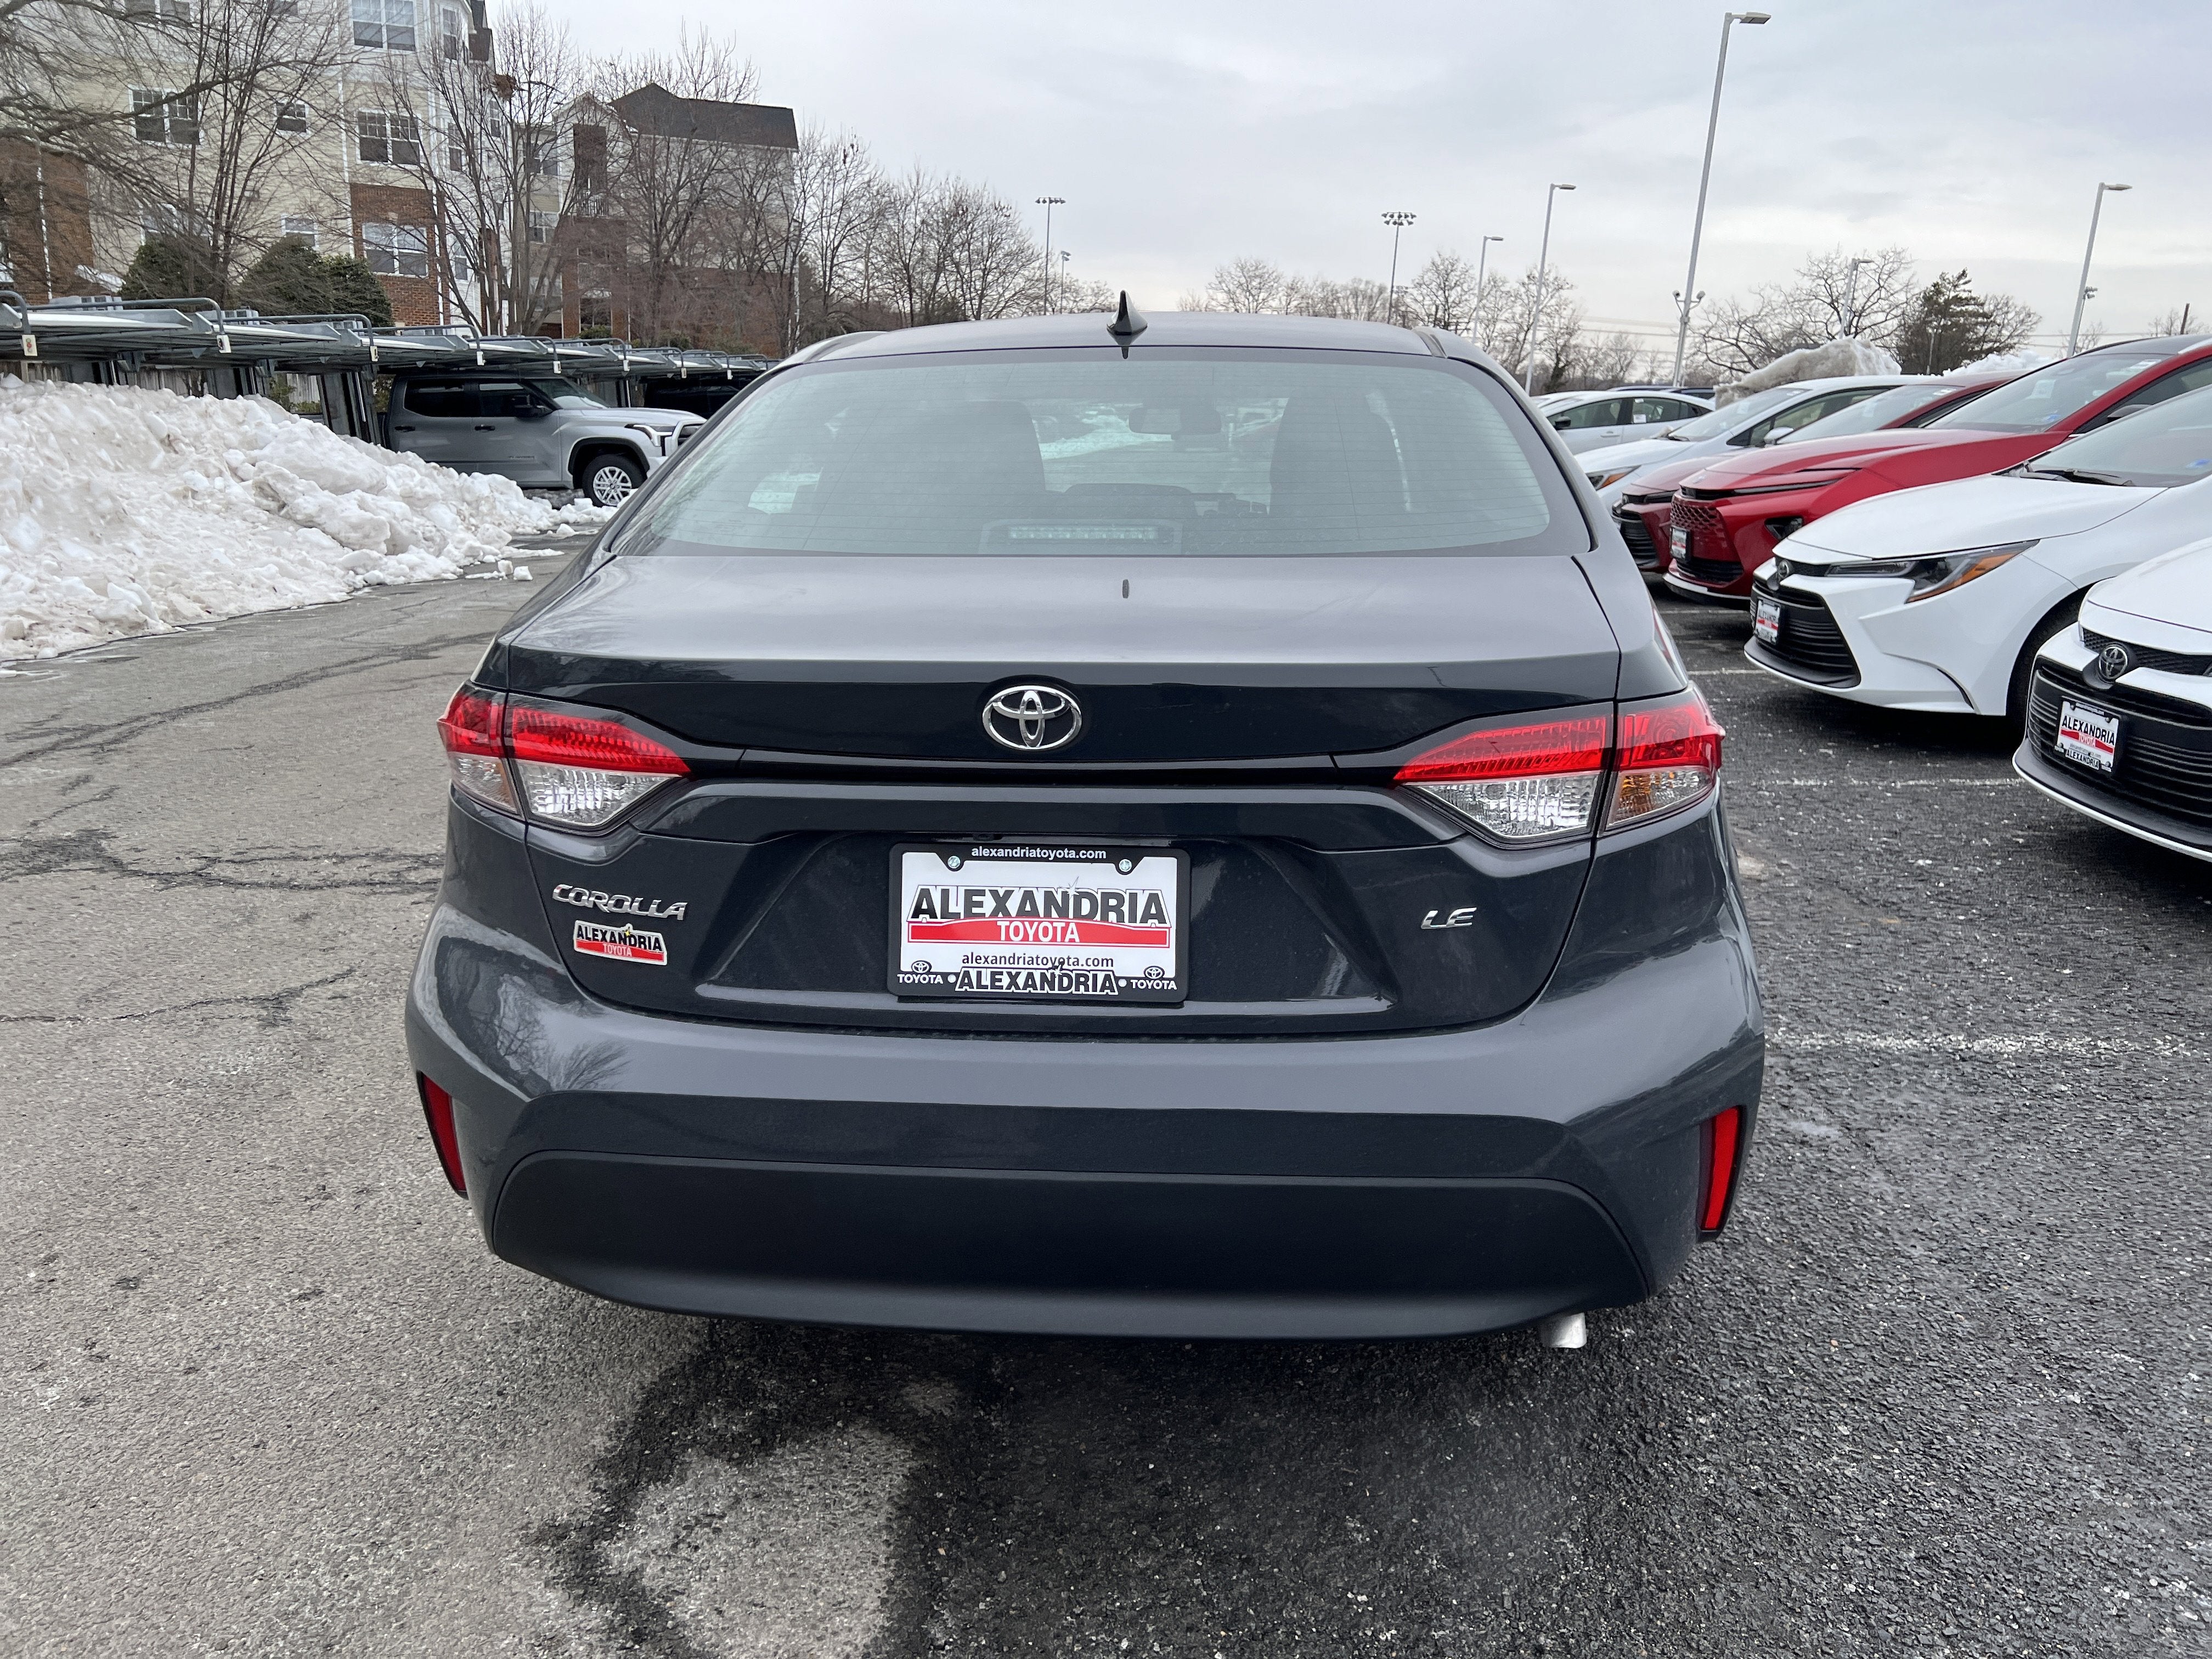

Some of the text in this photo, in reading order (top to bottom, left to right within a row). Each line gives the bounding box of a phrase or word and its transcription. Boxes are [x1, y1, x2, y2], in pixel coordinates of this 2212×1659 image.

[2062, 715, 2115, 746] ALEXANDRIA
[2066, 749, 2099, 769] ALEXANDRIA
[971, 845, 1107, 861] alexandriatoyota.com
[552, 883, 688, 921] COROLLA
[911, 887, 1168, 925] ALEXANDRIA
[1420, 907, 1477, 929] LE
[577, 924, 663, 952] ALEXANDRIA
[996, 920, 1080, 943] TOYOTA
[603, 943, 633, 957] TOYOTA
[962, 951, 1114, 969] alexandriatoyota.com
[896, 973, 944, 985] TOYOTA
[956, 968, 1117, 994] ALEXANDRIA
[1130, 979, 1177, 990] TOYOTA
